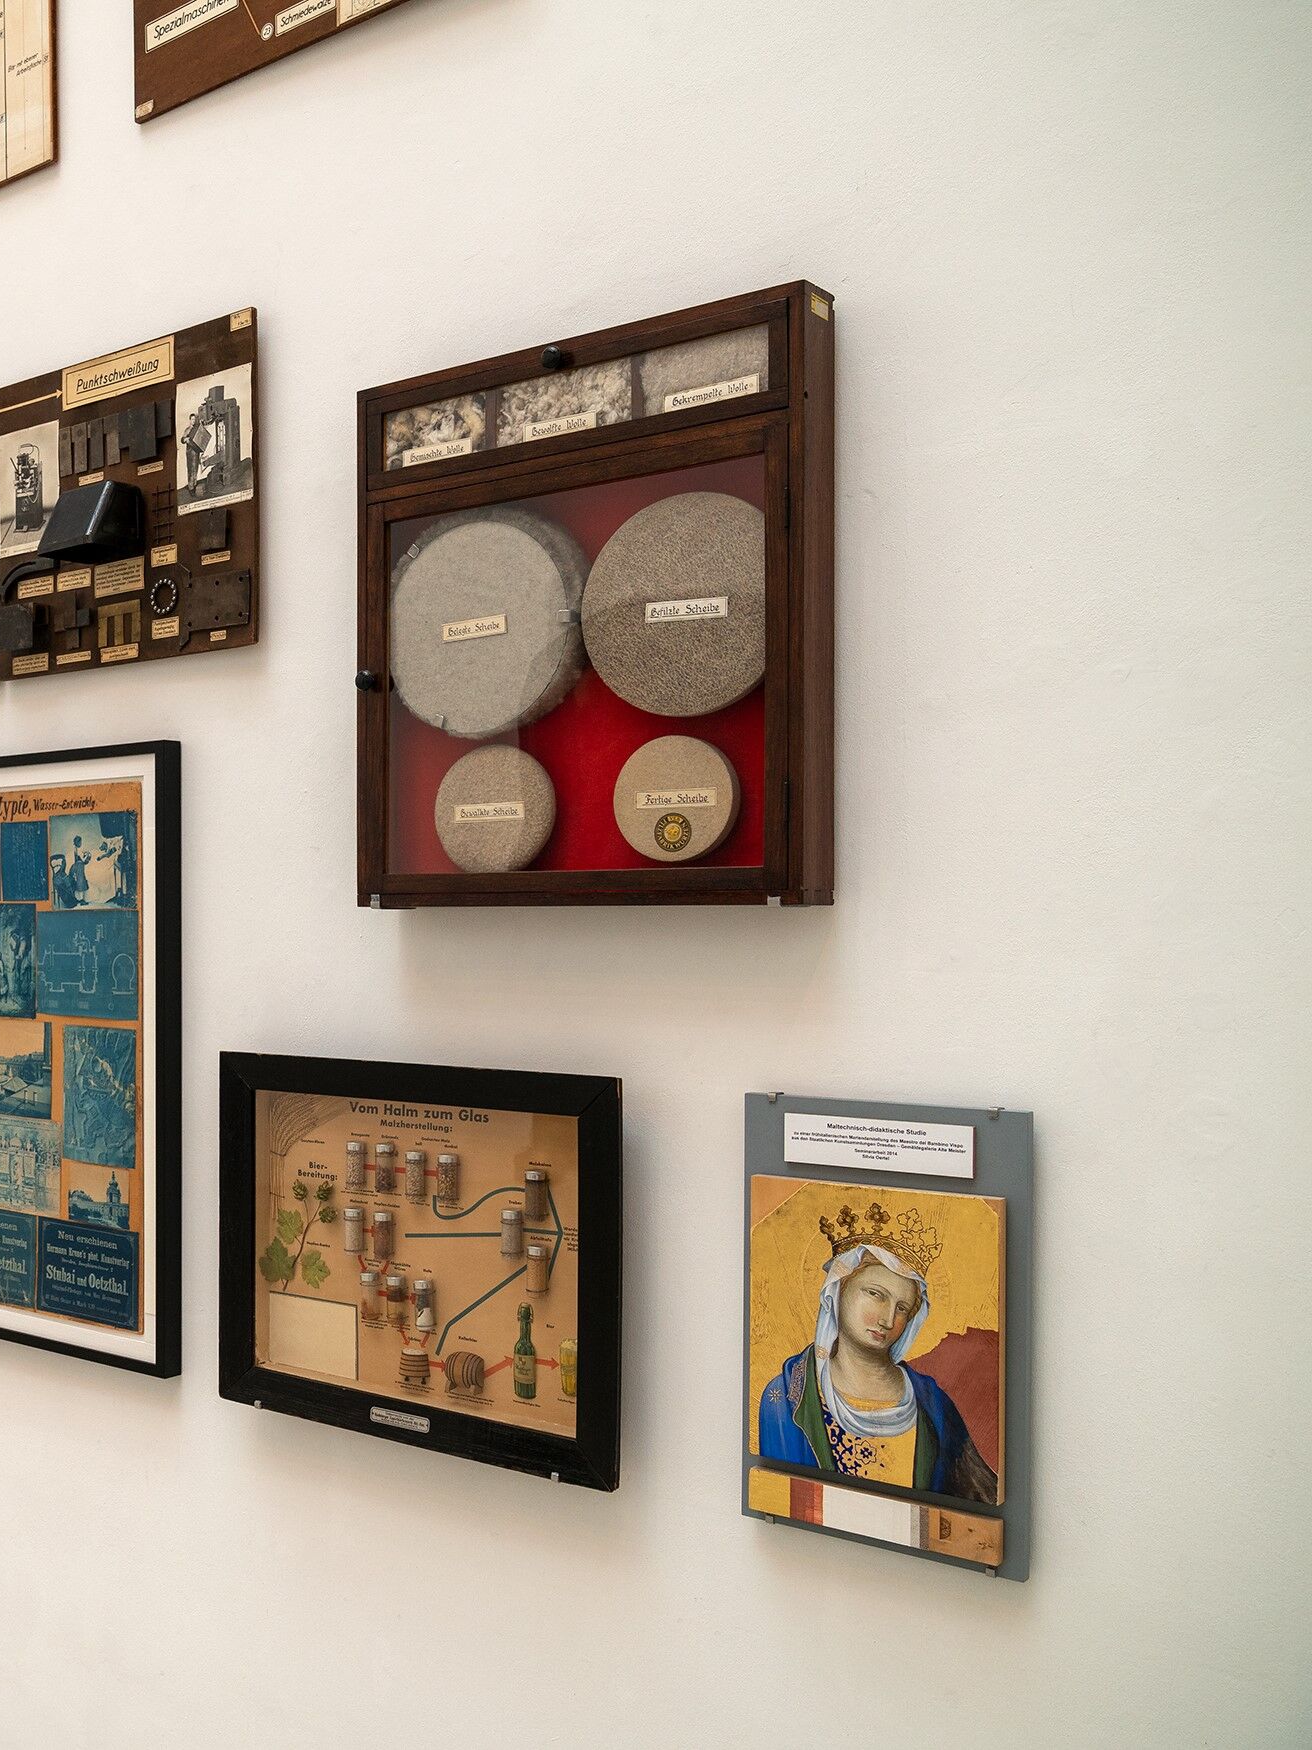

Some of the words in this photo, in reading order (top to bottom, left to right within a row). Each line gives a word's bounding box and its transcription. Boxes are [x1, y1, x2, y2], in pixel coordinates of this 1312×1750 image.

[76, 358, 159, 393] Punktschweißung
[727, 382, 749, 394] Wolle
[566, 417, 587, 429] Wolle
[446, 444, 464, 455] Wolle
[685, 601, 720, 616] Scheibe
[475, 620, 500, 633] Scheibe
[644, 793, 672, 807] Fertige
[676, 791, 708, 804] Scheibe
[493, 805, 519, 817] Scheibe
[349, 1101, 378, 1116] Vom
[384, 1103, 418, 1118] Halm
[424, 1109, 453, 1122] zum
[458, 1108, 489, 1124] Glas
[380, 1119, 454, 1133] Malzherstellung:
[827, 1123, 904, 1134] Maltechnisch-didaktische
[309, 1161, 328, 1170] Bier-
[297, 1170, 338, 1181] Bereitung:
[57, 1230, 74, 1242] Neu
[46, 1264, 76, 1284] Stubai
[88, 1273, 129, 1296] Oetzthal.
